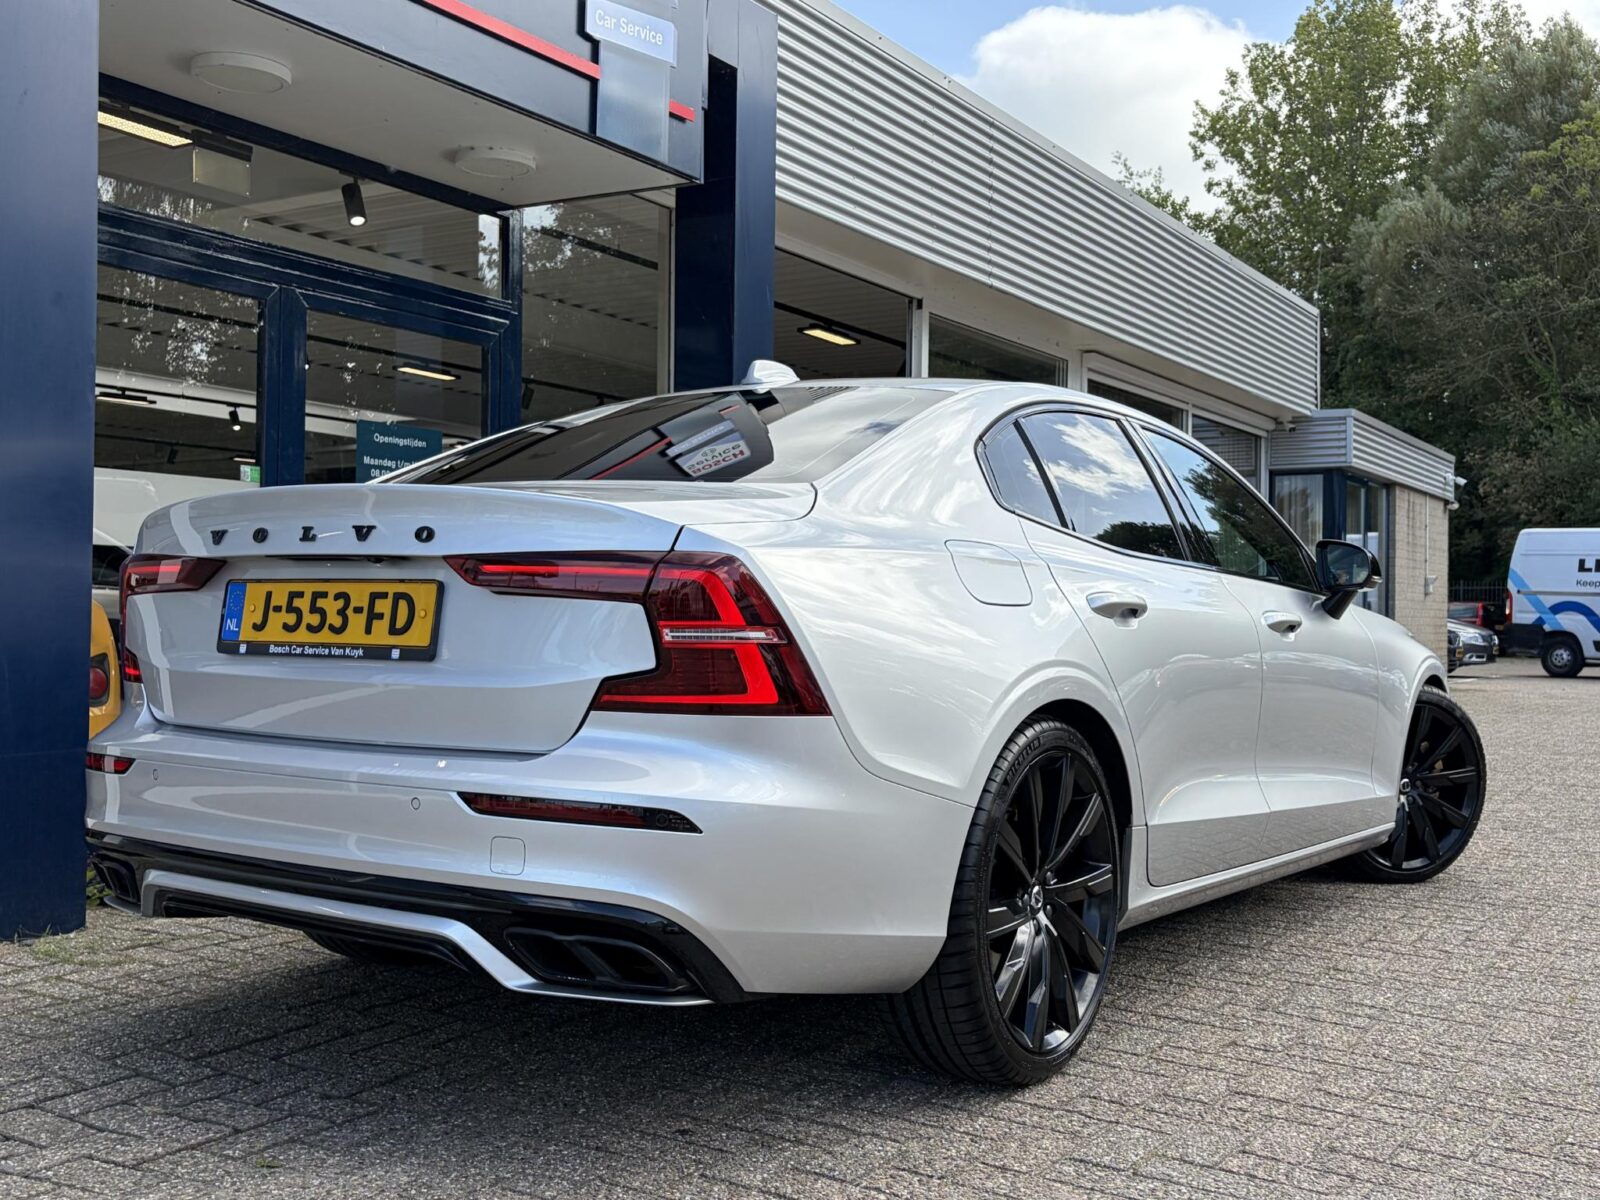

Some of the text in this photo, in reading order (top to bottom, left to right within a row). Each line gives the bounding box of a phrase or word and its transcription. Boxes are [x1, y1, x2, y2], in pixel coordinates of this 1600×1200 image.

[595, 9, 663, 45] Car Service
[373, 432, 427, 448] Openingstijden
[363, 455, 396, 469] Maandag
[210, 524, 436, 546] VOLVO
[251, 590, 416, 636] J-553-FD
[226, 618, 239, 632] NL
[269, 644, 364, 658] Bosch Car Service Van Kuyk
